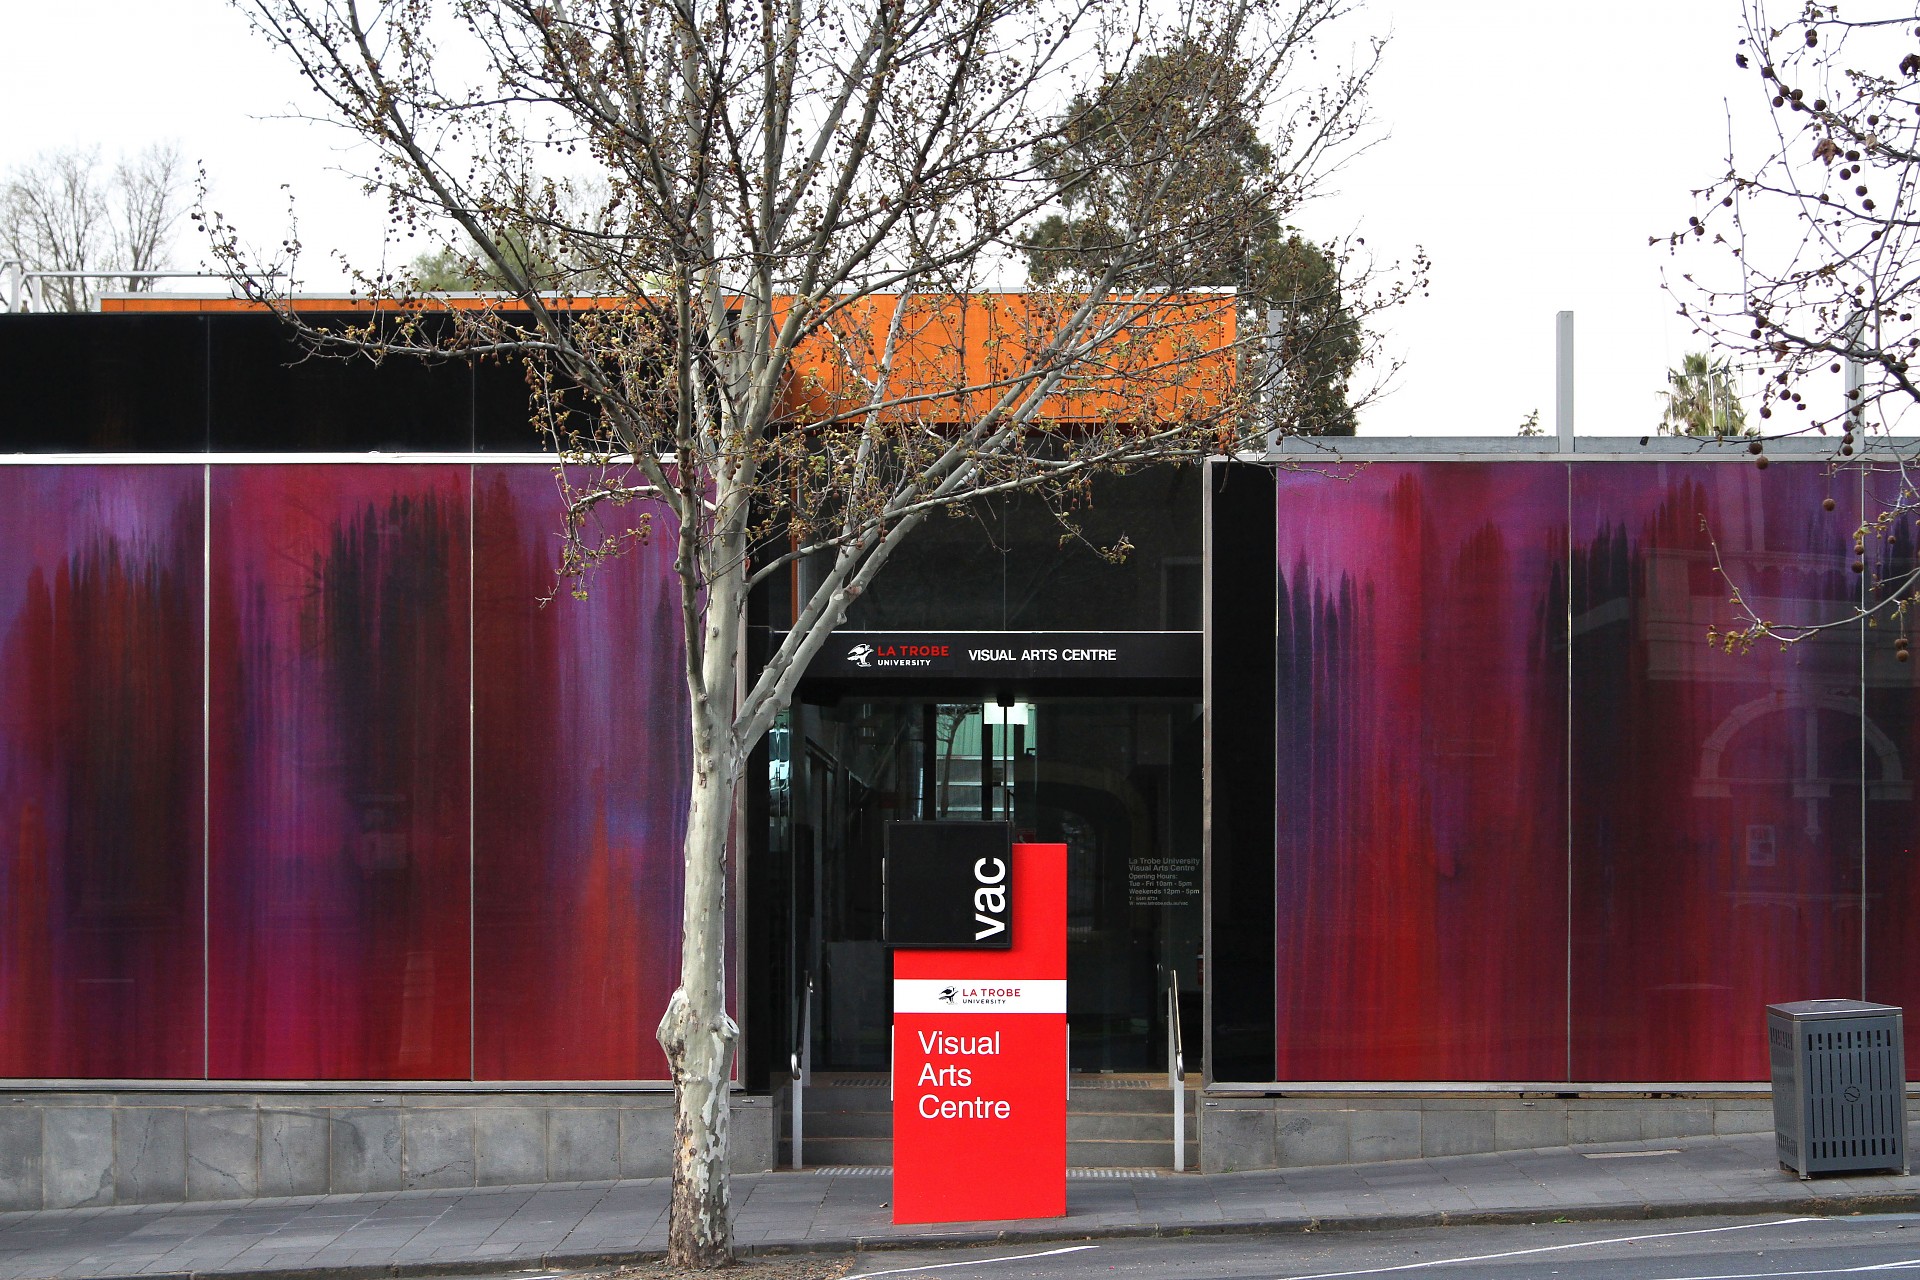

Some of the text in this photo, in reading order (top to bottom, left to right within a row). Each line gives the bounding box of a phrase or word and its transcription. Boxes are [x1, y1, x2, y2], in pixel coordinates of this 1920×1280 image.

[877, 646, 950, 657] LA TROBE
[967, 648, 1117, 662] VISUAL ARTS CENTRE
[877, 659, 932, 667] UNIVERSITY
[1163, 858, 1200, 866] University
[1163, 888, 1181, 896] 12pm
[1185, 888, 1200, 896] 5pm
[973, 857, 1006, 941] vac
[962, 988, 1021, 997] LA TROBE
[917, 1030, 1000, 1055] Visual
[917, 1062, 972, 1087] Arts
[918, 1093, 1011, 1119] Centre
